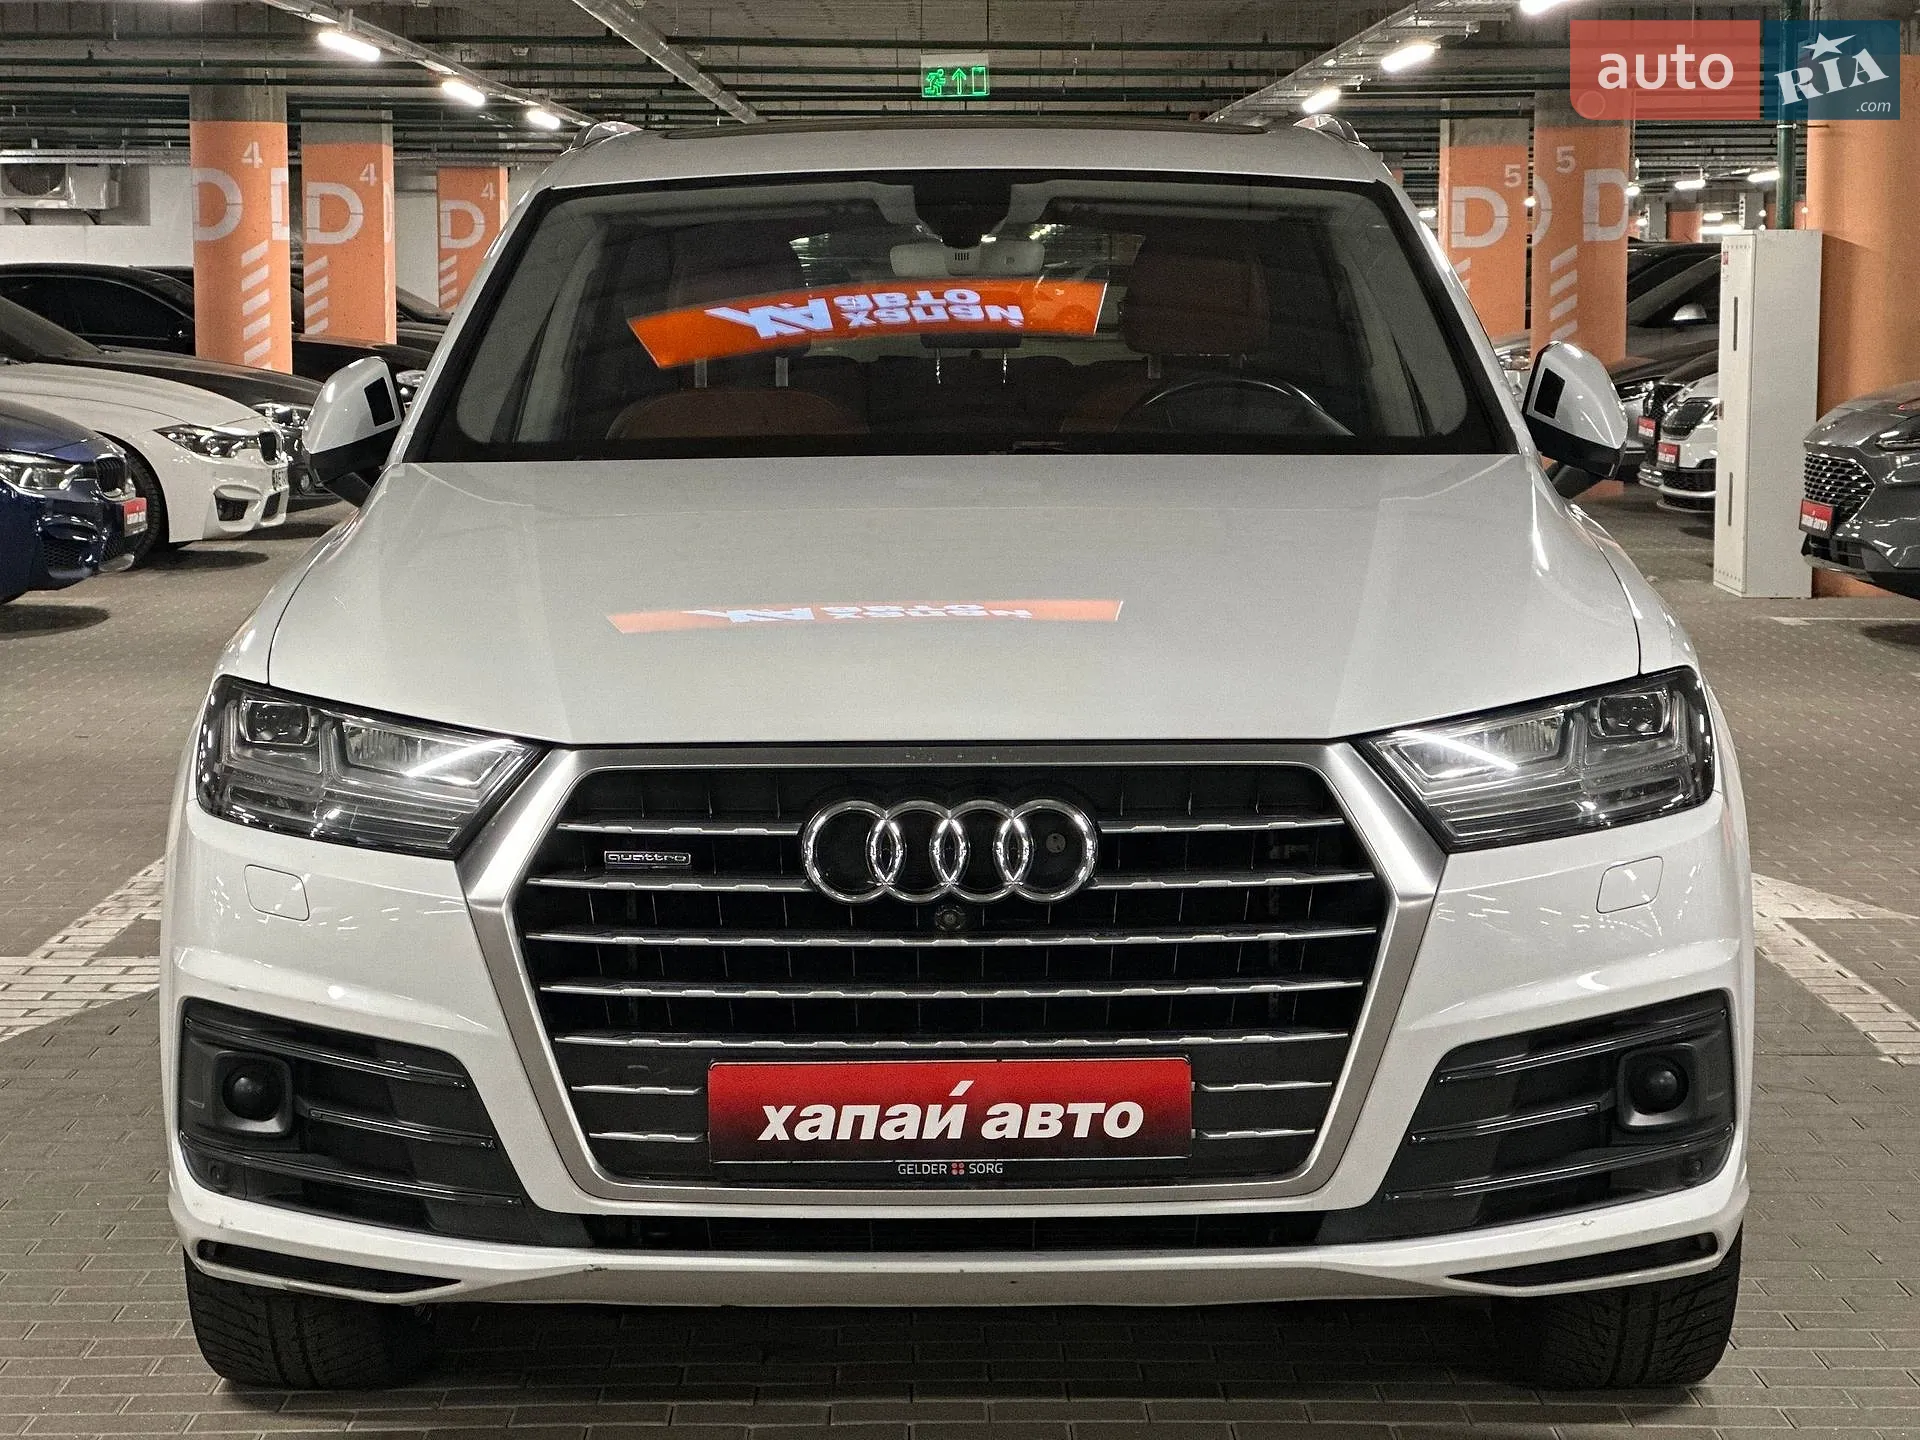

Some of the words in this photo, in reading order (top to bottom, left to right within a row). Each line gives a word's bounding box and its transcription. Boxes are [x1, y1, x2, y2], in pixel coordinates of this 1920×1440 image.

[241, 141, 263, 168] 4
[1556, 146, 1576, 173] 5
[360, 163, 377, 186] 4
[1504, 164, 1521, 188] 5
[192, 167, 243, 241] D
[480, 182, 496, 200] 4
[306, 182, 363, 244] D
[1452, 186, 1510, 248] D
[1583, 168, 1629, 242] D
[440, 200, 485, 249] D
[607, 853, 687, 863] quattro
[981, 1101, 1144, 1140] авто
[897, 1163, 948, 1176] GELDER
[968, 1162, 1004, 1175] SORG
